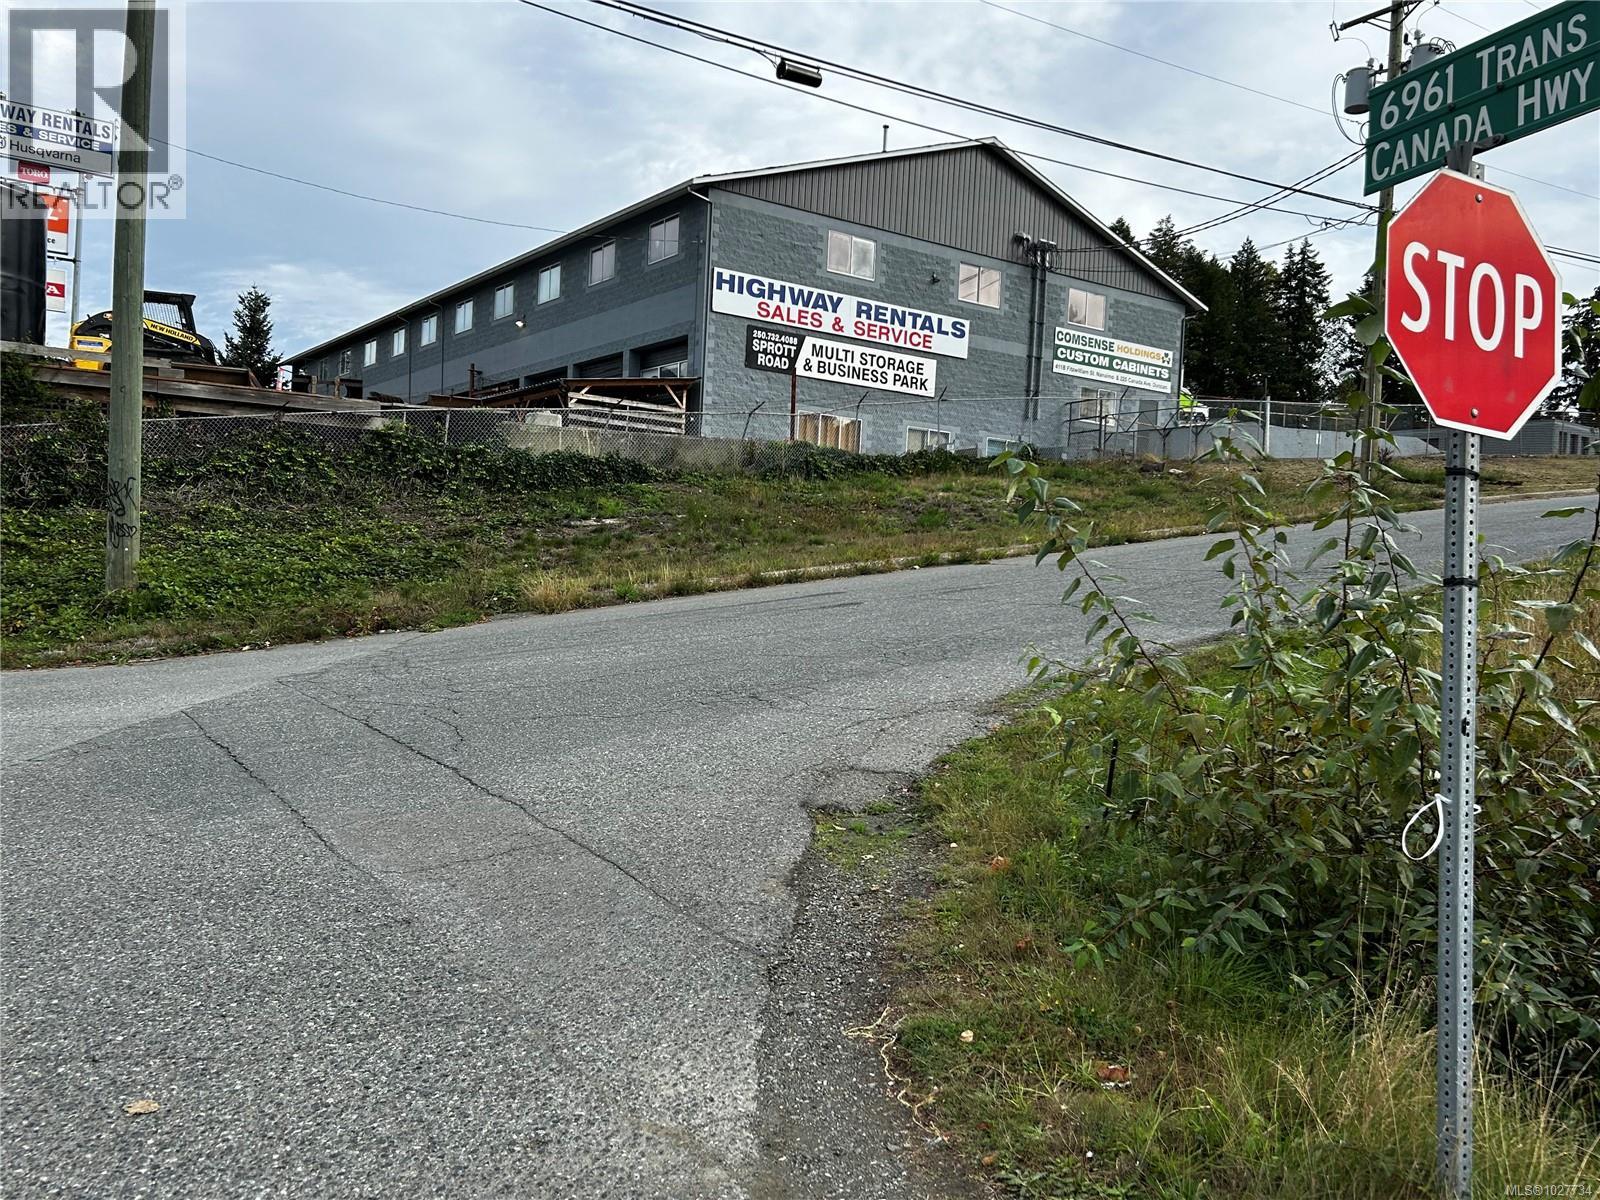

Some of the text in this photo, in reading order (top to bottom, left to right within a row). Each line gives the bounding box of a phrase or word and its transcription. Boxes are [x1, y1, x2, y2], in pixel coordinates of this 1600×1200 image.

[1380, 13, 1588, 130] 6961 TRANS
[42, 112, 110, 139] RENTALS
[1371, 61, 1595, 182] CANADA HWY
[10, 139, 81, 164] Husqvarna
[23, 127, 33, 138] &
[38, 130, 100, 151] SERVICE
[21, 166, 49, 179] TORO
[716, 271, 966, 339] HIGHWAY RENTALS
[1400, 241, 1543, 359] STOP
[150, 322, 194, 342] NEW HOLLAND
[756, 301, 933, 350] SALES & SERVICE
[752, 338, 797, 358] SPROTT
[811, 343, 925, 376] MULTI STORAGE
[1056, 330, 1162, 360] COMSENSE HOLDINGS
[757, 353, 789, 370] ROAD
[803, 357, 928, 391] & BUSINESS PARK
[1057, 347, 1170, 379] CUSTOM CABINETS
